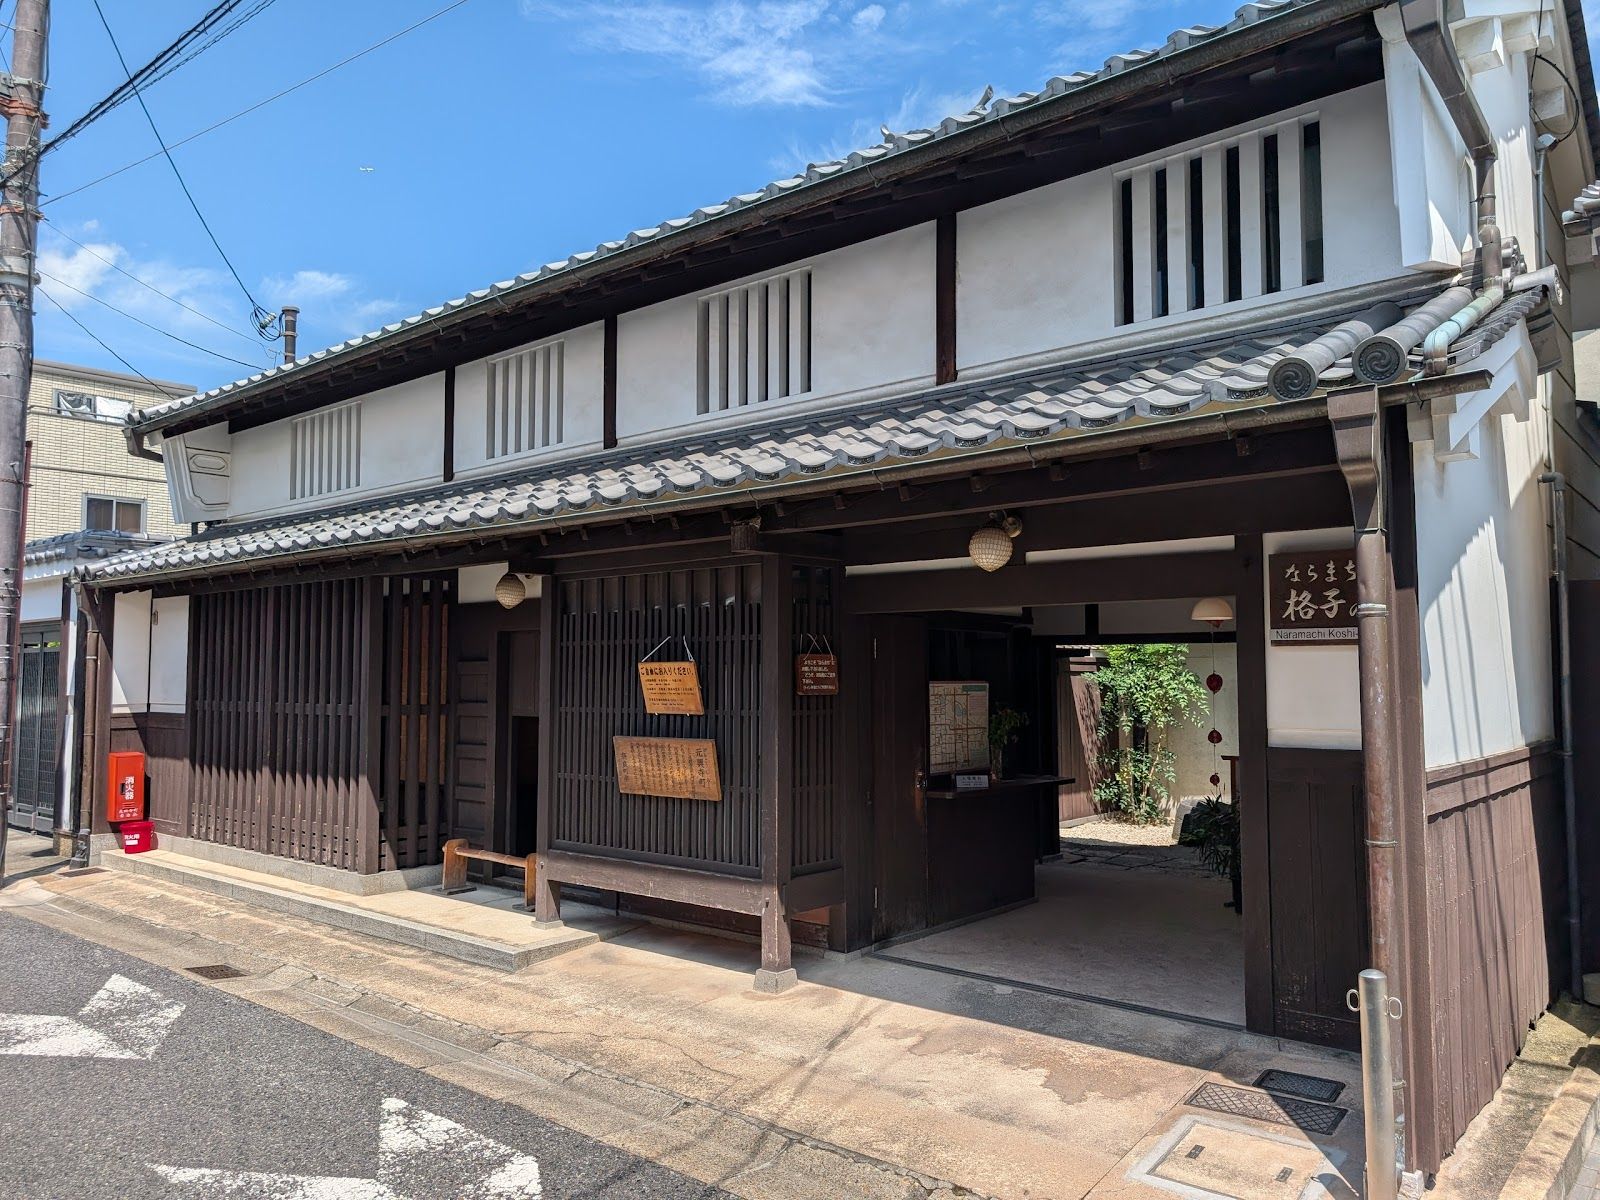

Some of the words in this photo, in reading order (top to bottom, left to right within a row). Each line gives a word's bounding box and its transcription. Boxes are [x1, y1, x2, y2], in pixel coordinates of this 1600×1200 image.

[1284, 559, 1357, 583] ならまち
[1275, 630, 1326, 640] Naramachi
[125, 776, 135, 800] 消火器
